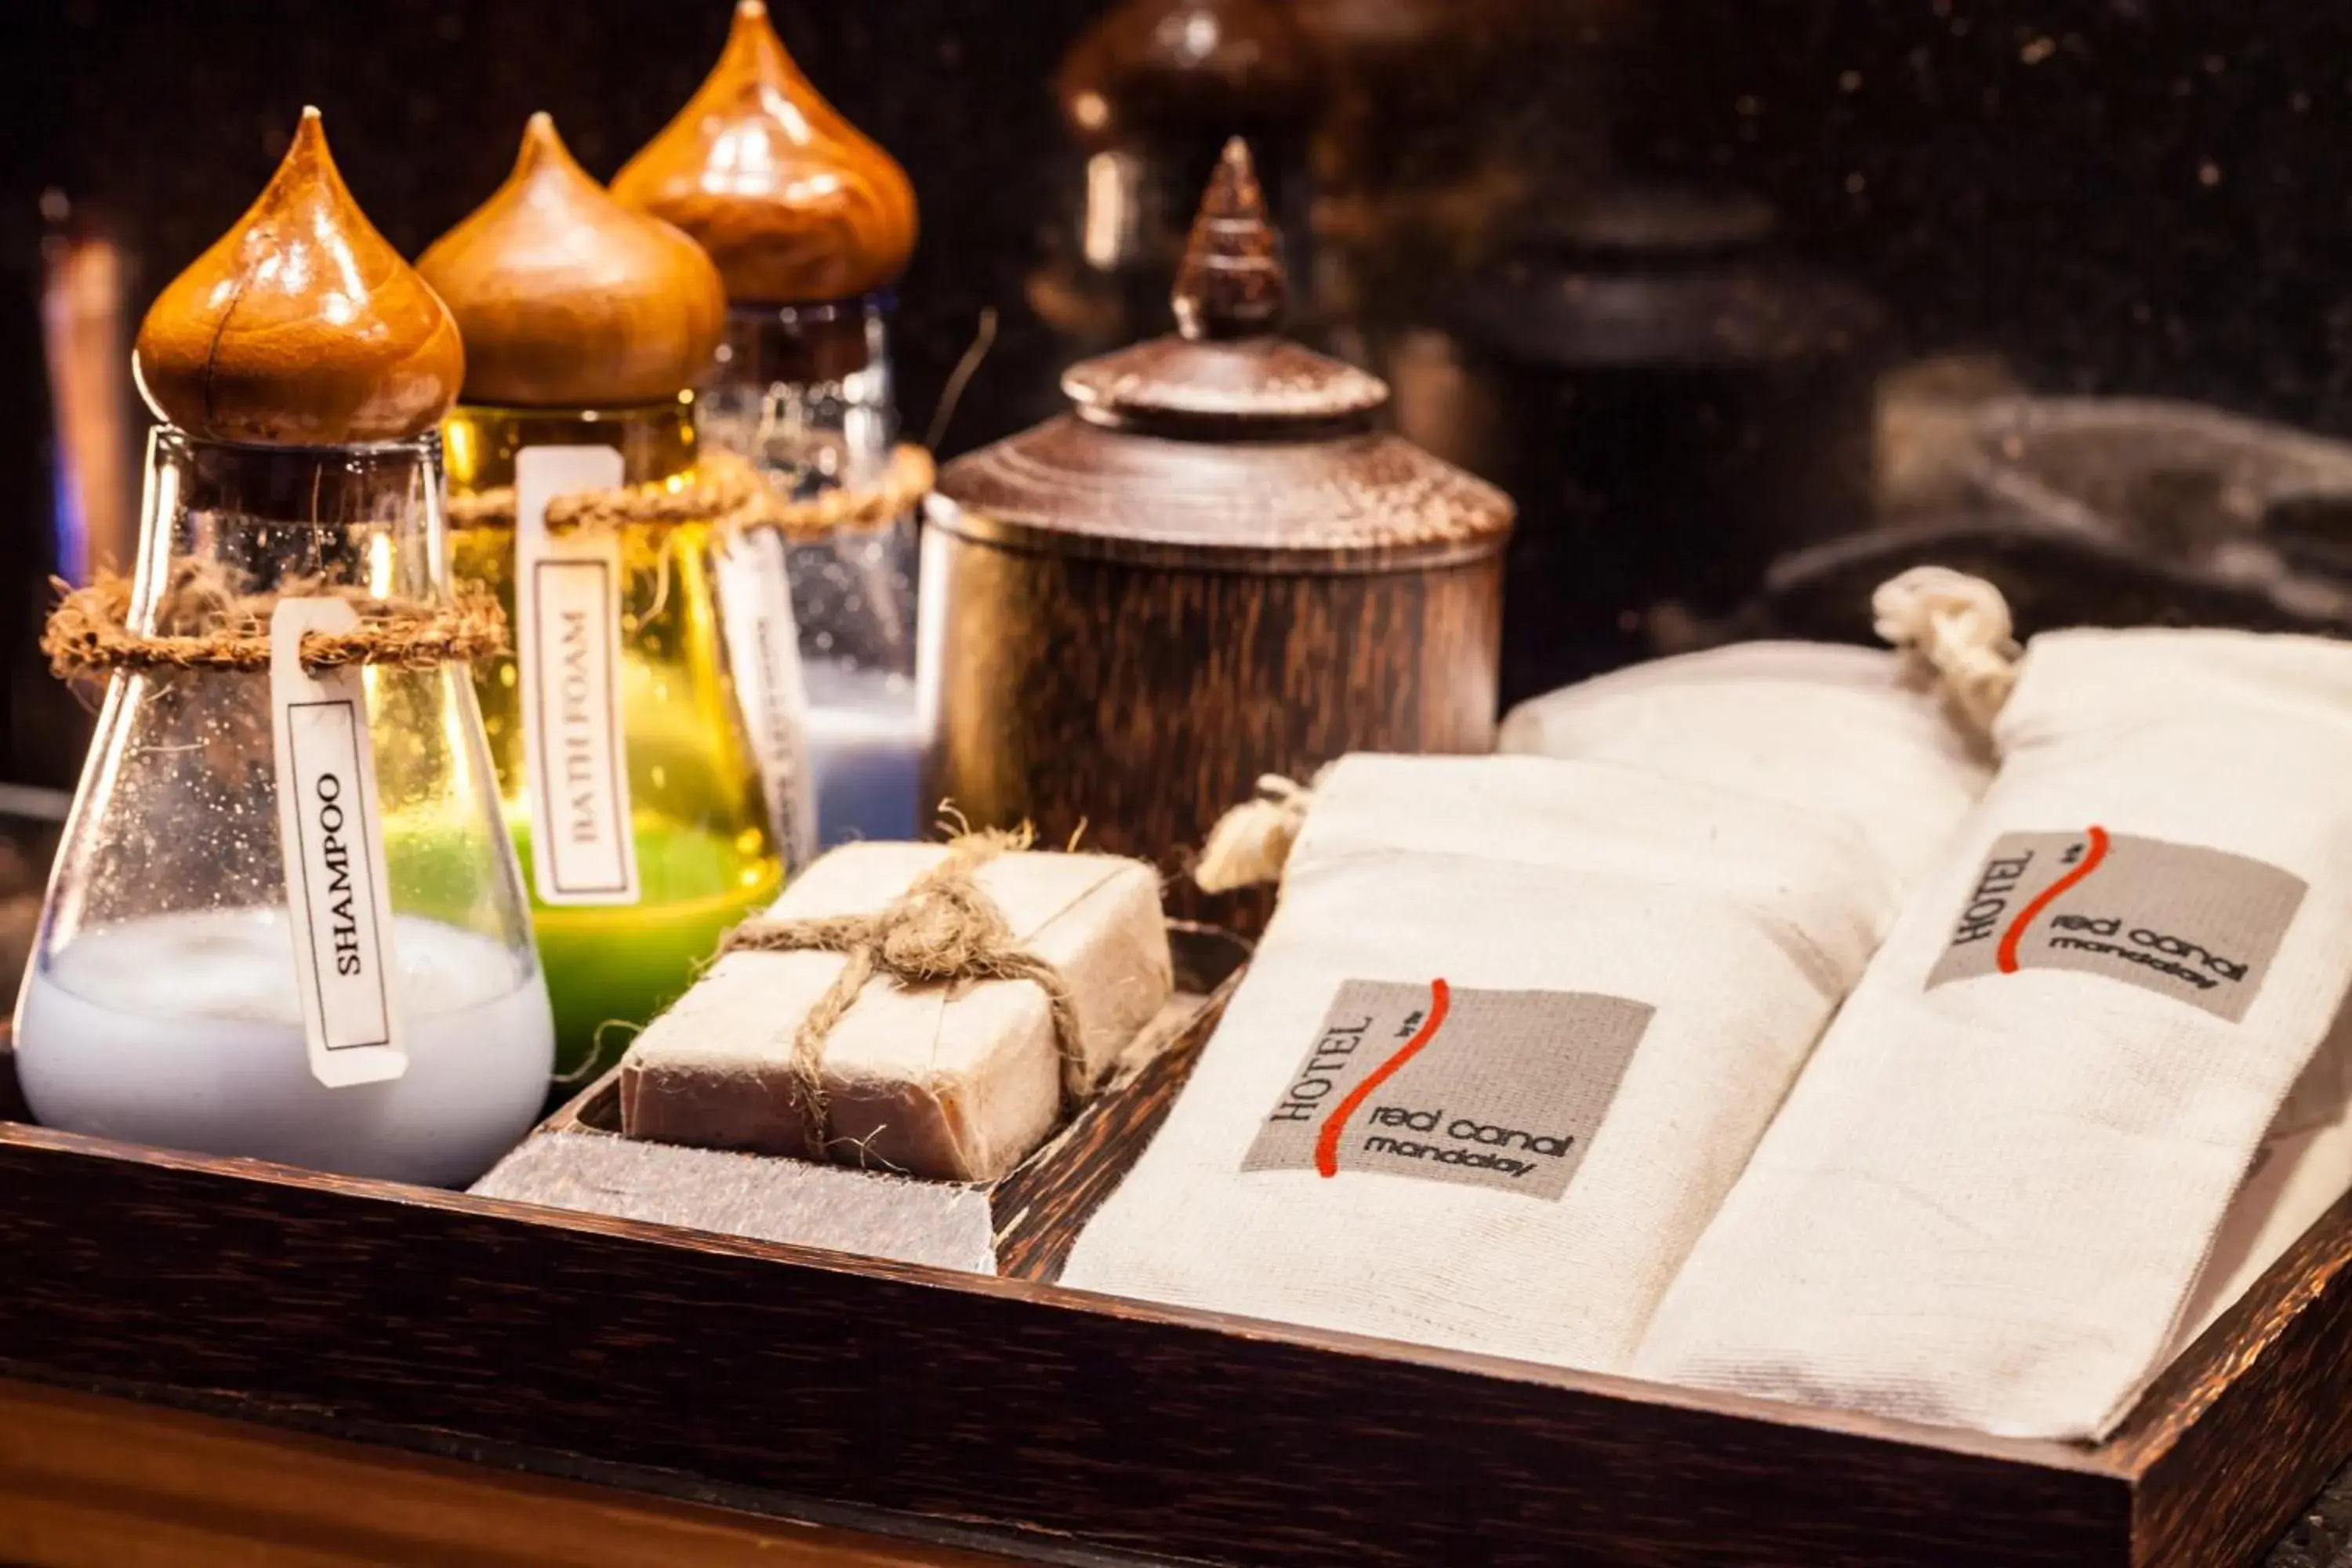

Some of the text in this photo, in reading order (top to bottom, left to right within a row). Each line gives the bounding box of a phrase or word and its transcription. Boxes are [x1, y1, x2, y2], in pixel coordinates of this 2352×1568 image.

[561, 611, 590, 725] FOAM
[317, 773, 361, 976] SHAMPOO
[1951, 850, 2034, 946] HOTEL
[2049, 937, 2219, 989] mandalay
[2050, 914, 2249, 982] red canal
[1269, 1017, 1374, 1122] HOTEL
[1363, 1136, 1537, 1178] mandalay
[1369, 1106, 1574, 1157] red canal
